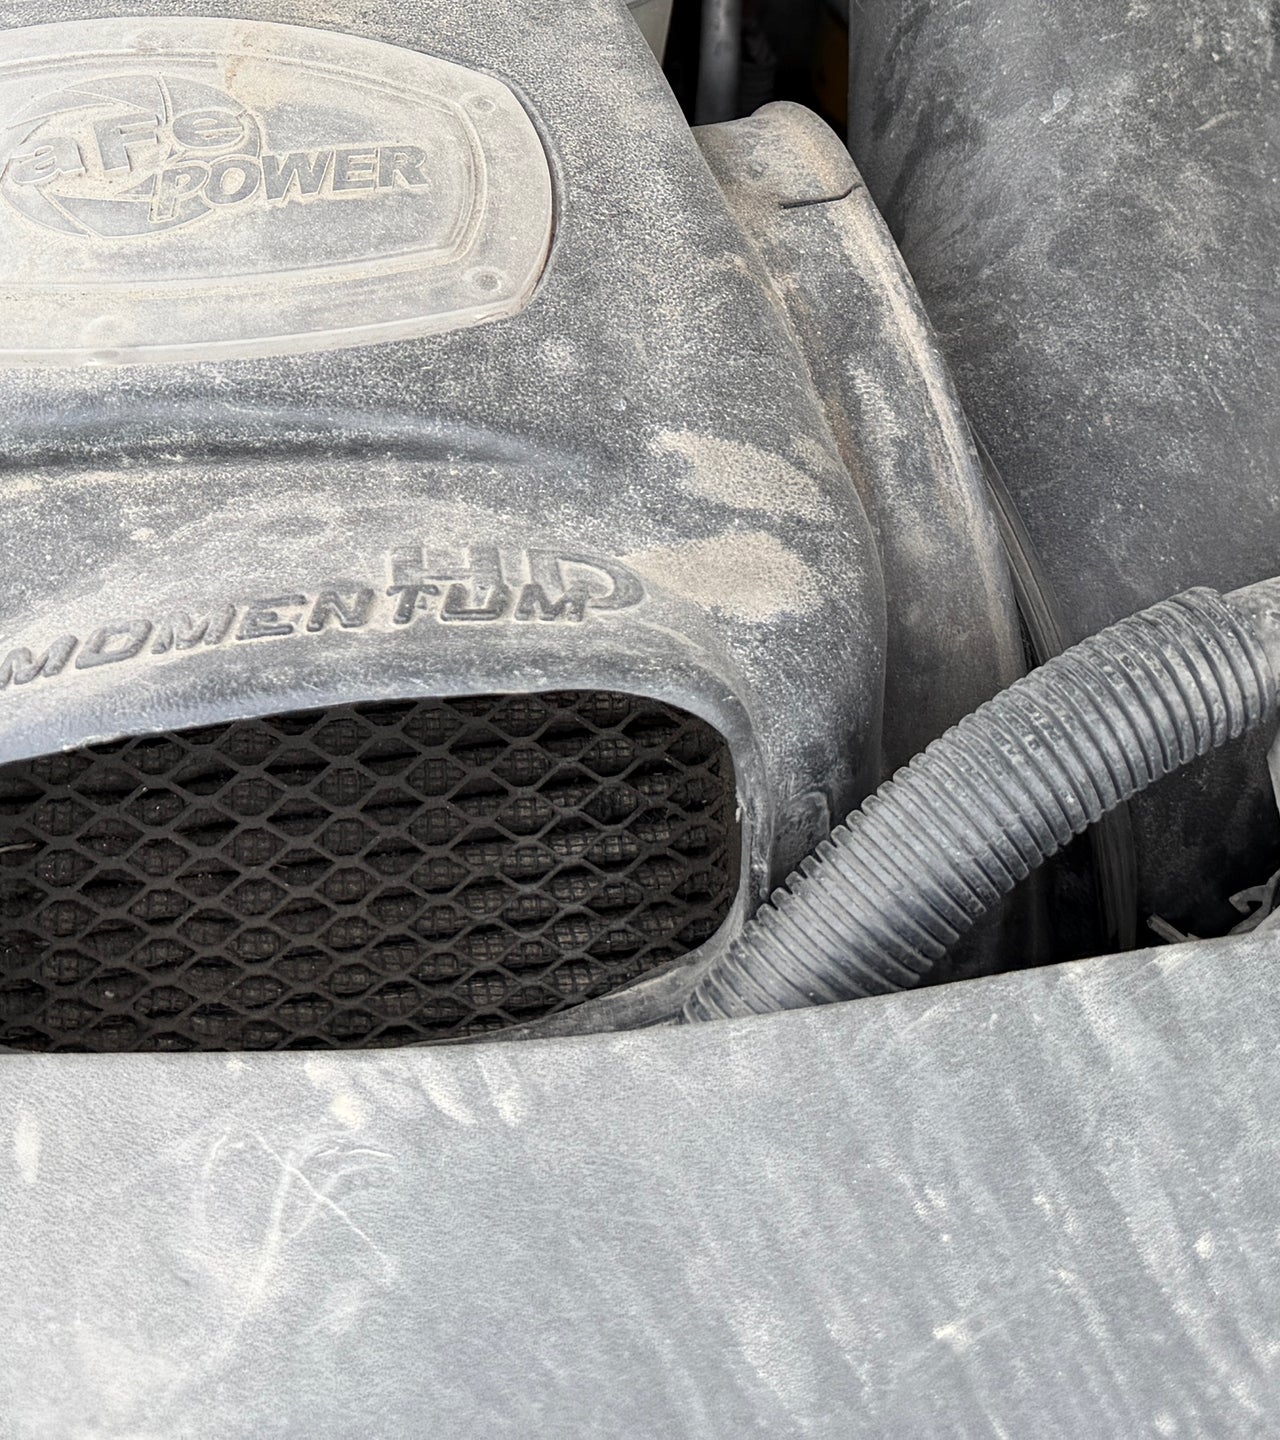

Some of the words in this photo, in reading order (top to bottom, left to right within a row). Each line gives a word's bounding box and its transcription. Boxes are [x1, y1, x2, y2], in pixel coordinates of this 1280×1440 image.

[9, 110, 246, 186] aFe
[148, 144, 431, 224] POWER
[388, 546, 648, 611] HD
